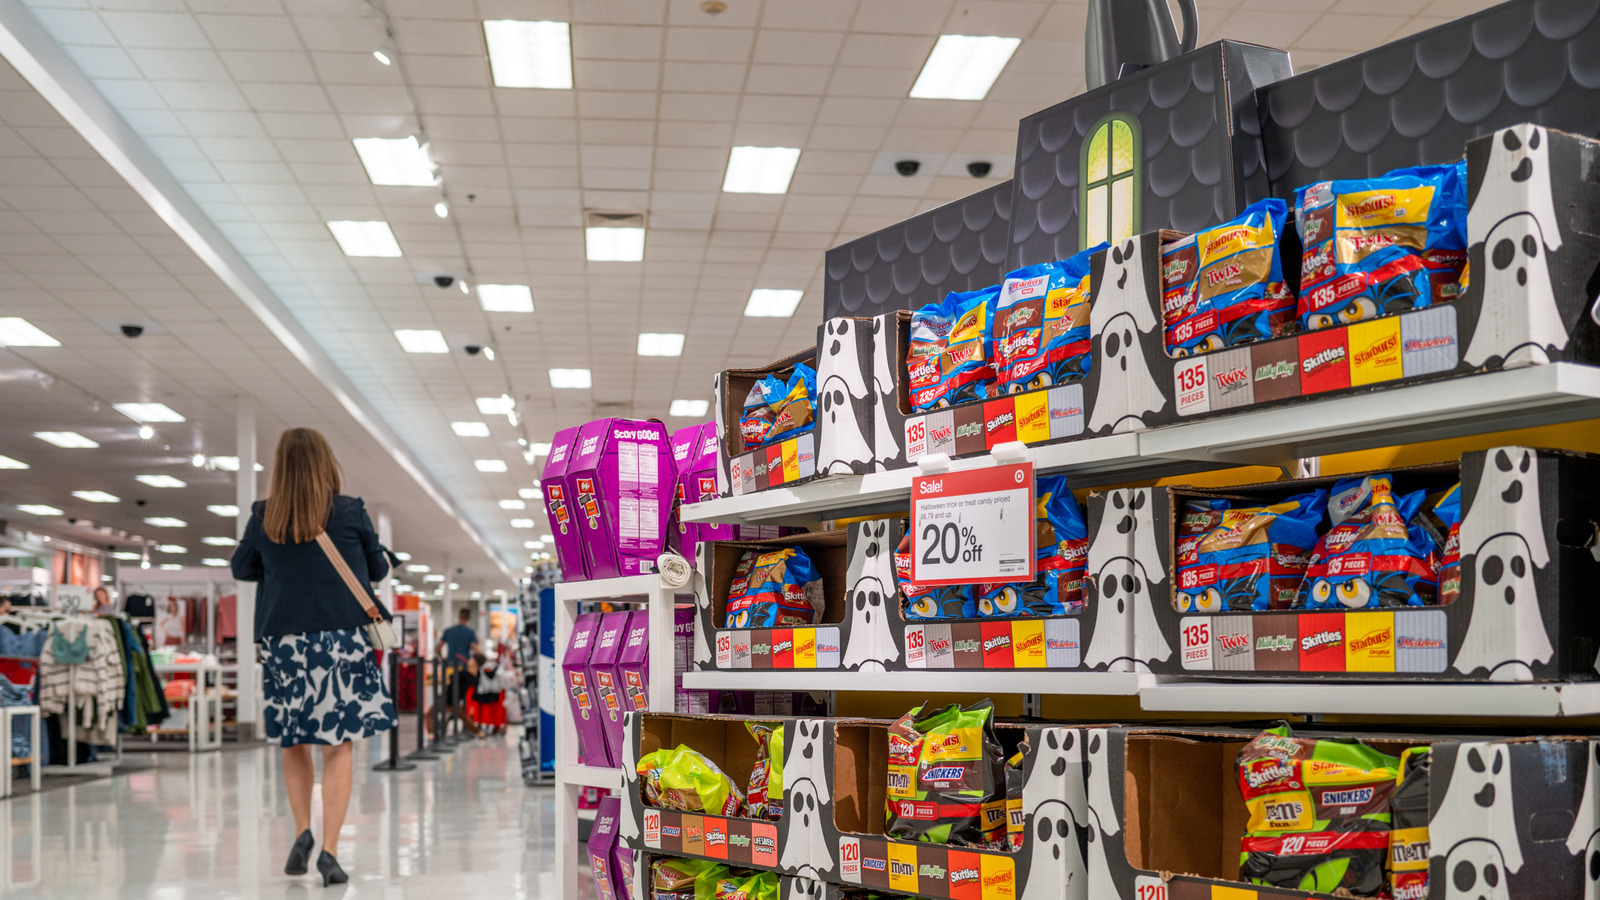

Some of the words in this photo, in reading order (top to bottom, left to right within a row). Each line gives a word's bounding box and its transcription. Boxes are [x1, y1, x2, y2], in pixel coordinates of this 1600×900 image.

[1346, 194, 1395, 217] Starburst
[1205, 228, 1249, 254] Starburst
[1348, 233, 1393, 251] Twix
[1170, 255, 1188, 273] Way
[1168, 274, 1183, 283] minis
[1206, 263, 1240, 286] Twix
[1226, 278, 1242, 286] minis
[1012, 278, 1043, 290] Musketeers
[1311, 284, 1335, 302] 135
[1338, 279, 1359, 294] PIECES
[1174, 323, 1193, 343] 135
[1195, 317, 1214, 330] PIECES
[1004, 335, 1034, 359] Skittles
[1353, 335, 1397, 368] Starburst
[1404, 340, 1416, 353] 3
[1413, 336, 1452, 350] Musketeers
[947, 346, 973, 364] Twix
[1302, 346, 1346, 373] Skittles
[1375, 356, 1397, 367] Original
[1013, 362, 1030, 378] 135
[1177, 364, 1205, 392] 135
[1255, 366, 1278, 381] Milky
[1276, 361, 1297, 379] Way
[1212, 368, 1247, 389] Twix
[918, 389, 934, 404] 135
[1181, 390, 1204, 405] PIECES
[1019, 405, 1046, 429] Starburst
[1055, 408, 1081, 418] Musketeers
[957, 426, 972, 438] Milky
[969, 422, 983, 435] Way
[986, 412, 1014, 433] Skittles
[614, 430, 637, 440] Scary
[906, 422, 925, 444] 135
[929, 425, 952, 442] Twix
[583, 436, 599, 448] Scary
[908, 443, 924, 454] PIECES
[732, 460, 741, 480] 135
[768, 455, 782, 472] Skittles
[742, 467, 753, 481] Twix
[920, 480, 943, 494] Sale!
[977, 498, 993, 506] candy
[994, 496, 1010, 504] priced
[1196, 514, 1211, 525] Way
[922, 522, 960, 565] 20
[963, 545, 983, 562] off
[1064, 546, 1088, 561] Skitt
[1277, 553, 1308, 567] Skittles
[1327, 557, 1343, 574] 135
[1344, 561, 1366, 569] PIECES
[1181, 569, 1197, 587] 135
[1199, 571, 1214, 581] PIECES
[576, 629, 590, 639] Scary
[603, 628, 617, 639] Scary
[631, 627, 645, 637] Scary
[906, 630, 923, 650] 135
[1182, 623, 1209, 647] 135
[717, 636, 730, 652] 135
[734, 643, 749, 653] Twix
[773, 640, 792, 654] Skittles
[795, 637, 814, 655] Starburst
[928, 638, 949, 652] Twix
[984, 634, 1010, 652] Skittles
[1015, 633, 1043, 654] Starburst
[1216, 633, 1249, 650] Twix
[1256, 637, 1278, 651] Milky
[1275, 634, 1296, 649] Way
[1301, 630, 1342, 651] Skittles
[1350, 628, 1391, 654] Starburst
[1403, 637, 1442, 649] Musketeers
[908, 651, 923, 660] PIECES
[1186, 650, 1208, 660] PIECES
[1255, 737, 1277, 749] Milky
[1278, 739, 1304, 756] Way
[925, 767, 962, 779] SNICKERS
[1249, 765, 1294, 787] Skittles
[1323, 788, 1372, 804] SNICKERS
[900, 803, 914, 817] 120
[600, 816, 613, 825] Scary
[645, 814, 658, 830] 120
[1270, 820, 1290, 828] fun
[646, 832, 658, 840] PIECES
[663, 826, 680, 835] SNICKERS
[685, 825, 701, 837] Twix
[706, 831, 726, 842] Skittles
[840, 842, 858, 861] 120
[1281, 836, 1305, 854] 120
[1306, 840, 1328, 848] PIECES
[843, 864, 857, 872] PIECES
[864, 858, 886, 869] SNICKERS
[920, 864, 933, 877] Milky
[932, 866, 947, 880] Way
[950, 868, 979, 882] Skittles
[983, 871, 1012, 887] Starburst
[1137, 885, 1165, 900] 120
